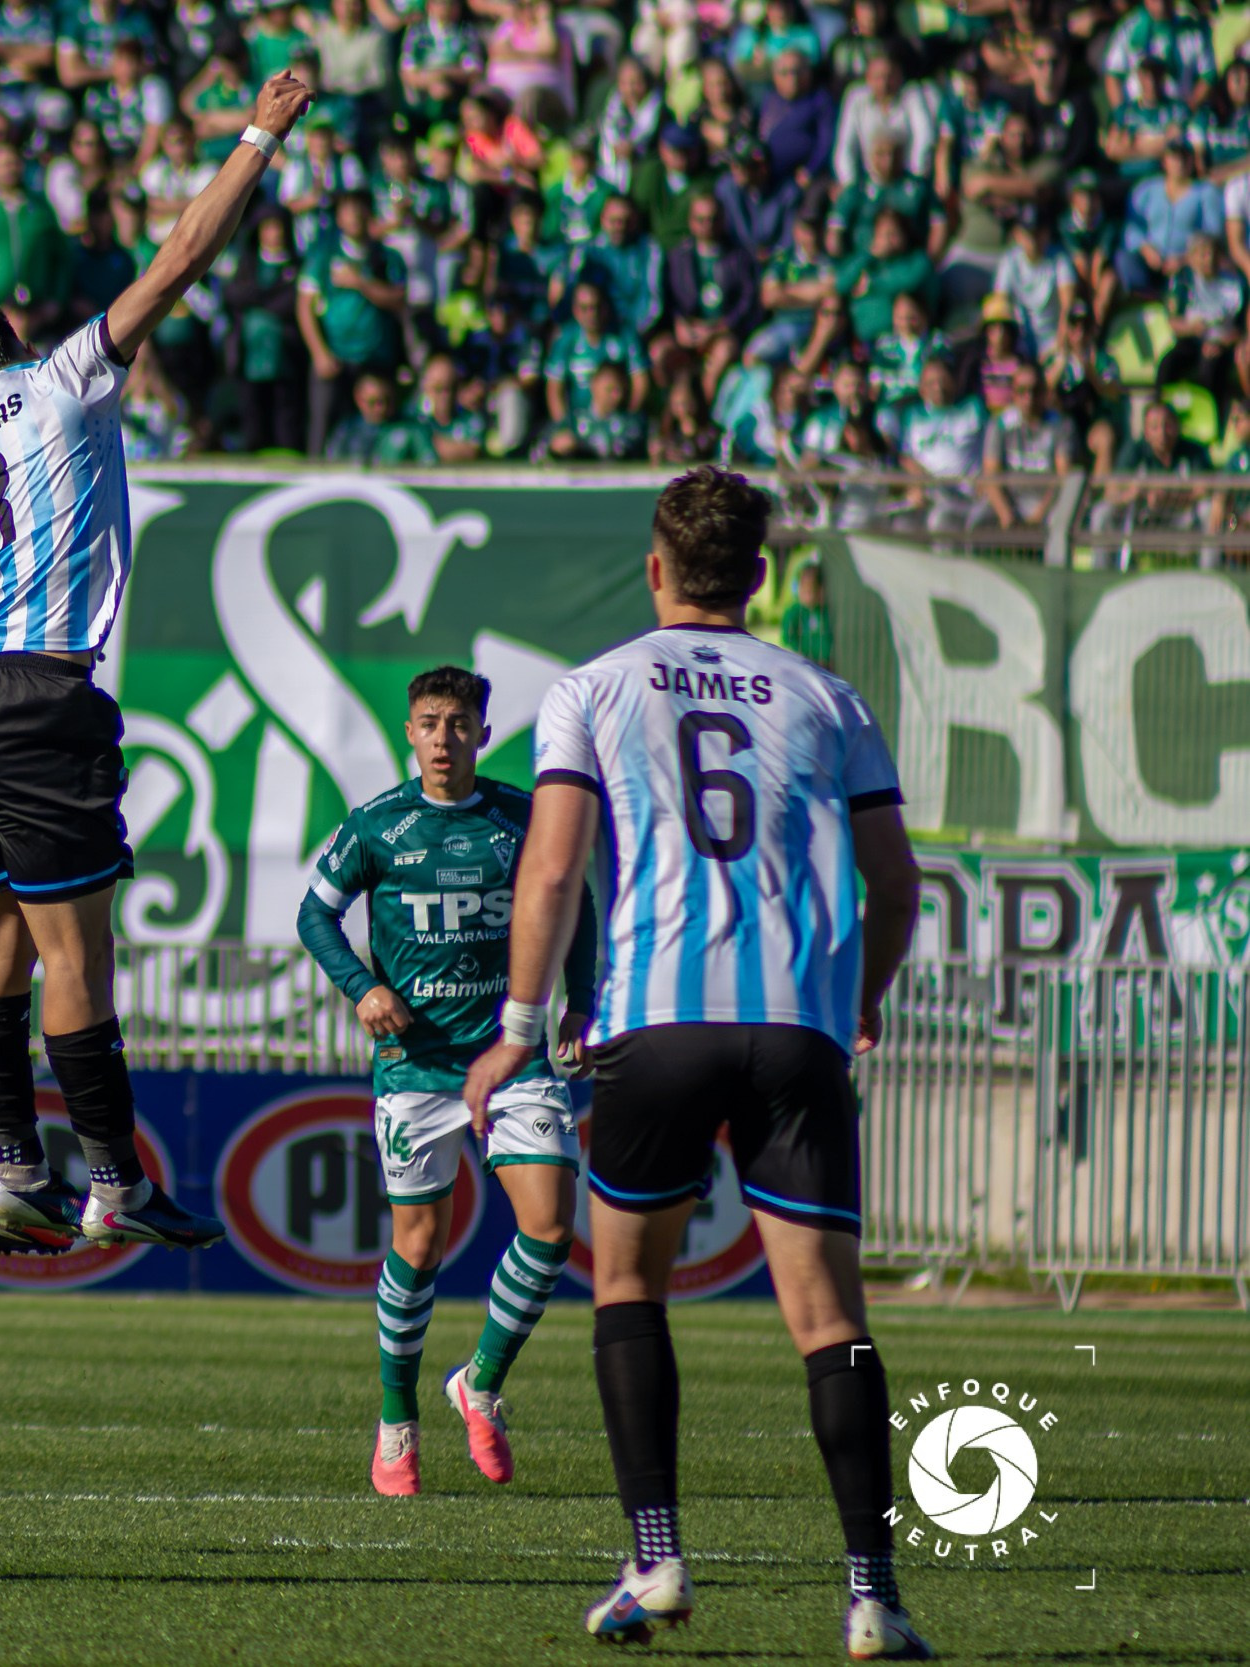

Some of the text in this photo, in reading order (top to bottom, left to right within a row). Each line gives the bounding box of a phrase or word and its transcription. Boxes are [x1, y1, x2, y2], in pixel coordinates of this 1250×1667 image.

[650, 662, 773, 705] JAMES
[679, 710, 756, 862] 6
[382, 809, 422, 844] Biozen
[401, 889, 513, 931] TPS
[413, 972, 510, 998] Latamwin
[384, 1116, 412, 1162] 14
